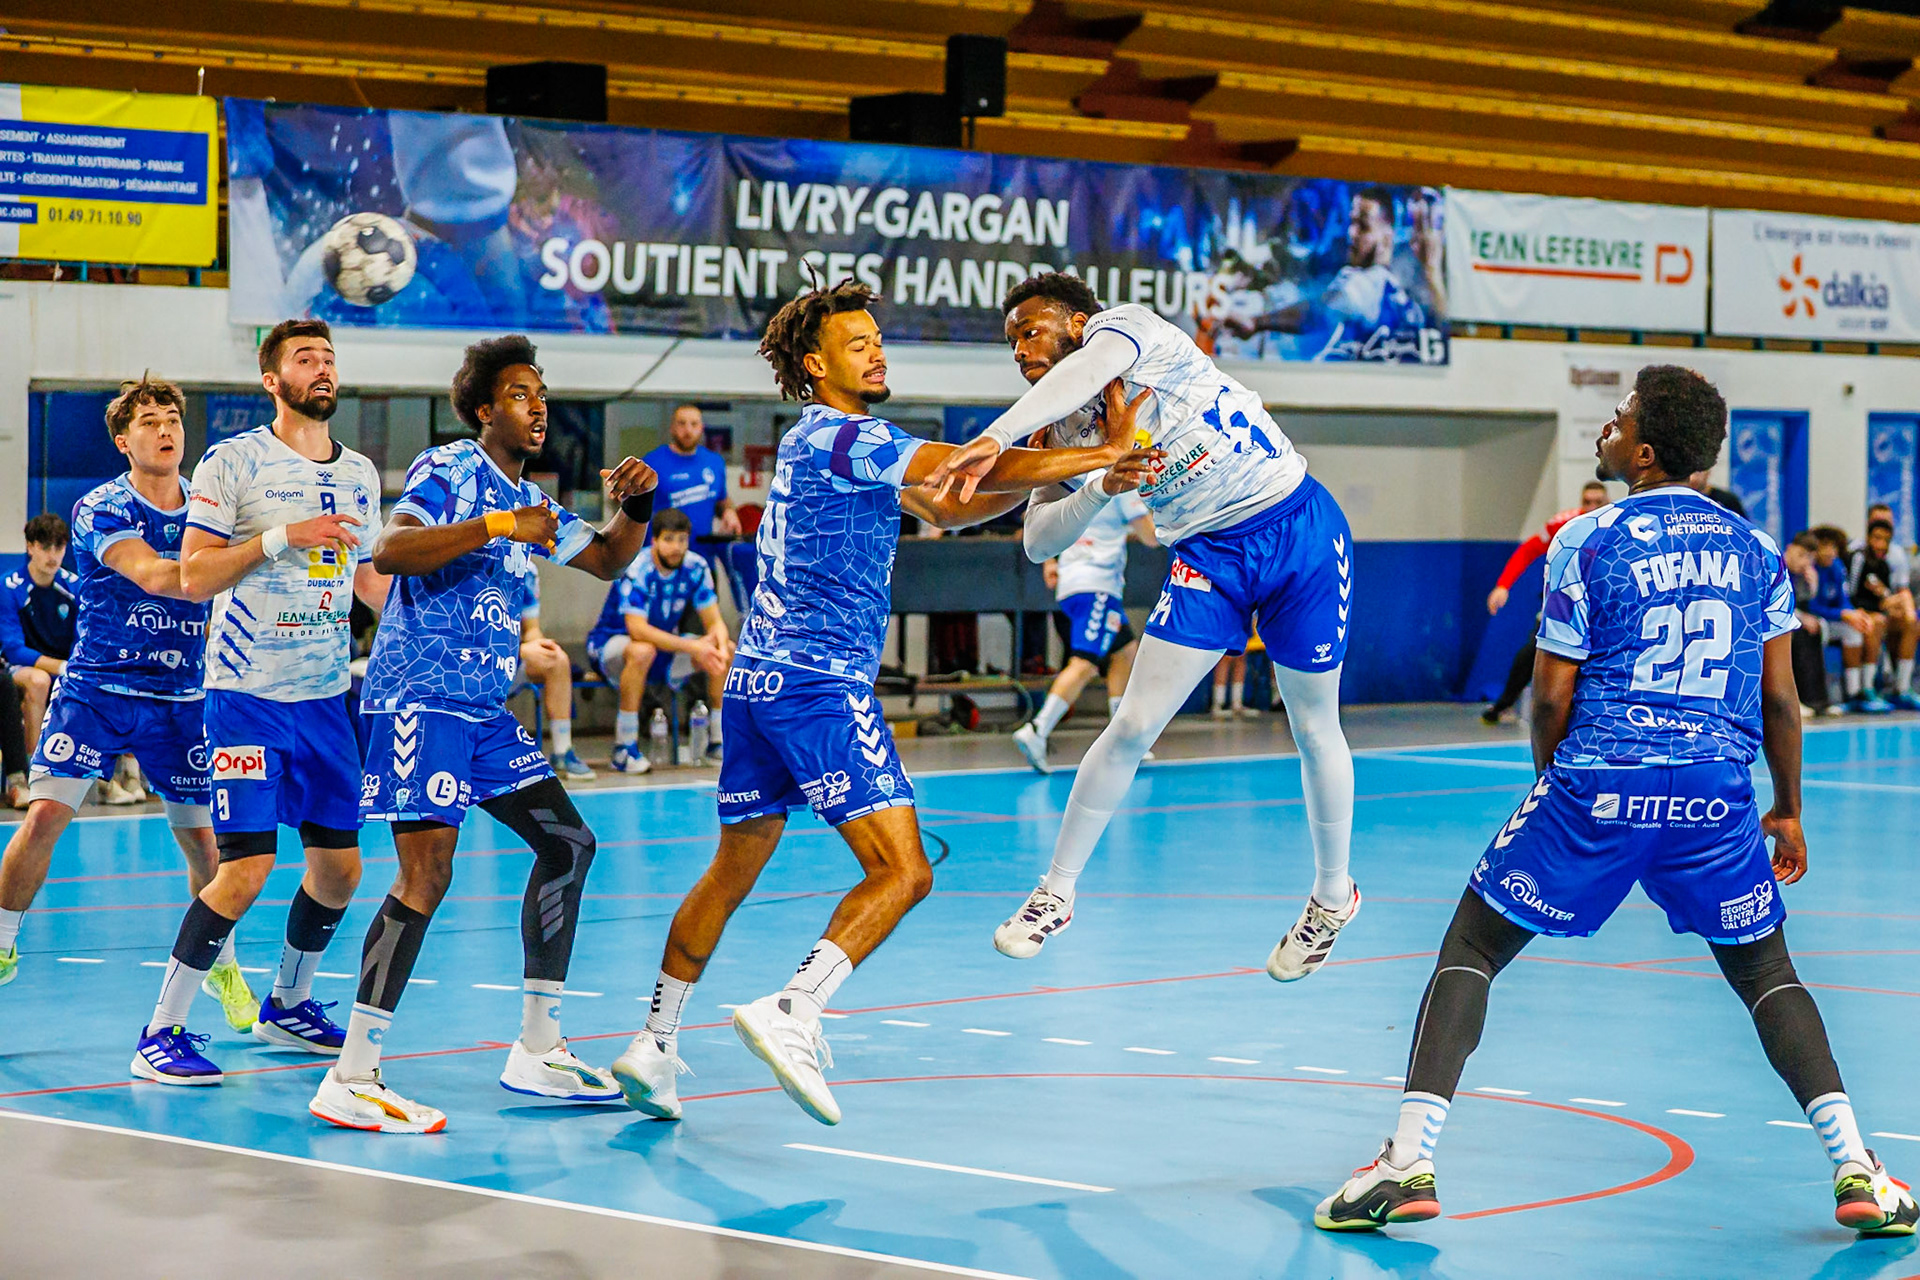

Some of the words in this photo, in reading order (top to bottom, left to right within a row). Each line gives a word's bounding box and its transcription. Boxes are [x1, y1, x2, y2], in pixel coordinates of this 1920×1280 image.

[46, 133, 126, 149] ASSAINISSEMENT
[32, 152, 76, 166] TRAVAUX
[77, 155, 141, 170] SOUTERRAINS
[736, 179, 1069, 248] LIVRY-GARGAN
[1534, 234, 1644, 269] LEFEBVRE
[539, 237, 789, 299] SOUTIENT
[798, 250, 884, 300] SES
[894, 255, 1238, 318] HANDLLEURS
[1823, 270, 1889, 309] dalkia
[265, 489, 304, 501] Origami
[1663, 512, 1721, 524] CHARTRES
[1630, 551, 1741, 598] FOFANA
[307, 580, 336, 588] DUBRAC
[277, 611, 306, 622] JEAN
[1630, 599, 1732, 699] 22
[214, 750, 263, 775] Orpi
[508, 750, 546, 769] CENTU
[170, 775, 212, 786] CENTUR
[718, 789, 761, 804] UALTER
[823, 794, 847, 809] LOIRE
[1626, 795, 1730, 822] FITECO
[1596, 818, 1628, 826] Expertise
[1499, 876, 1576, 922] AQUALTER
[1721, 907, 1756, 923] CENTRE
[1722, 920, 1739, 930] VAL
[1740, 917, 1752, 928] DE
